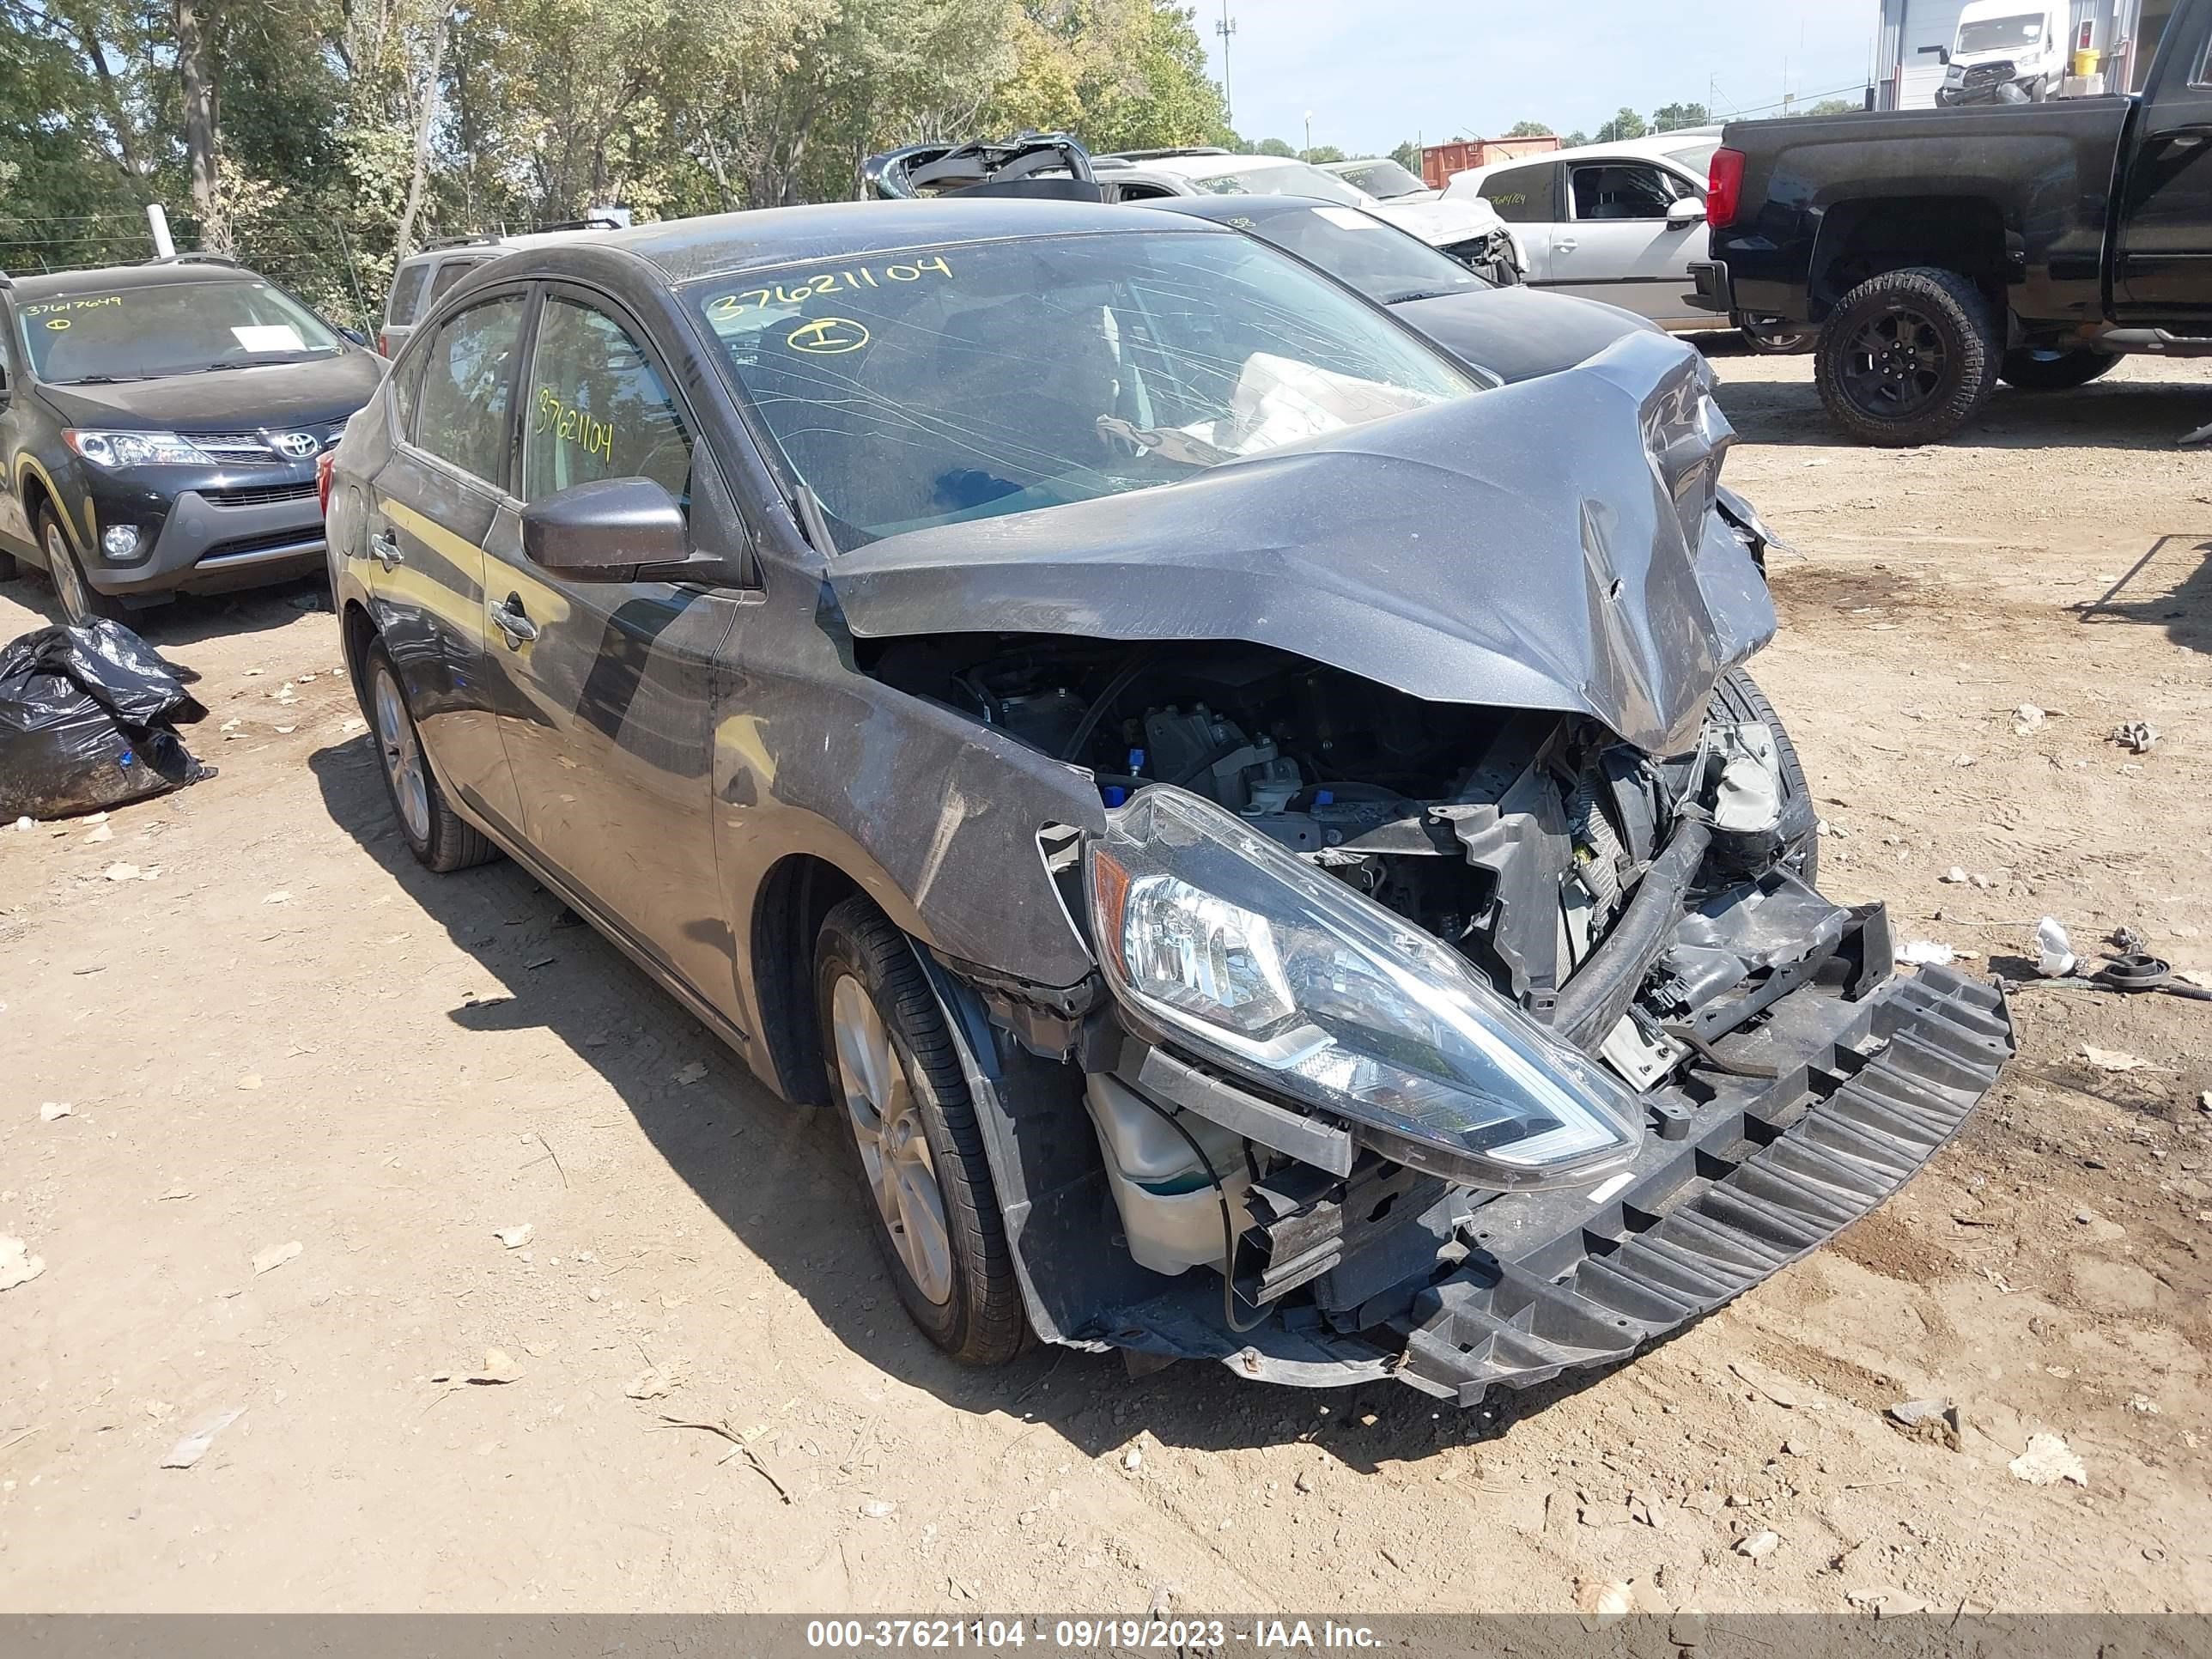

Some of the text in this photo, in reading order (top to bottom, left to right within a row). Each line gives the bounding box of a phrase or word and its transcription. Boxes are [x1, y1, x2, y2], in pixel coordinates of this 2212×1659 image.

[27, 296, 122, 316] 37617649
[711, 257, 952, 322] 37621104
[536, 388, 613, 465] 37621104
